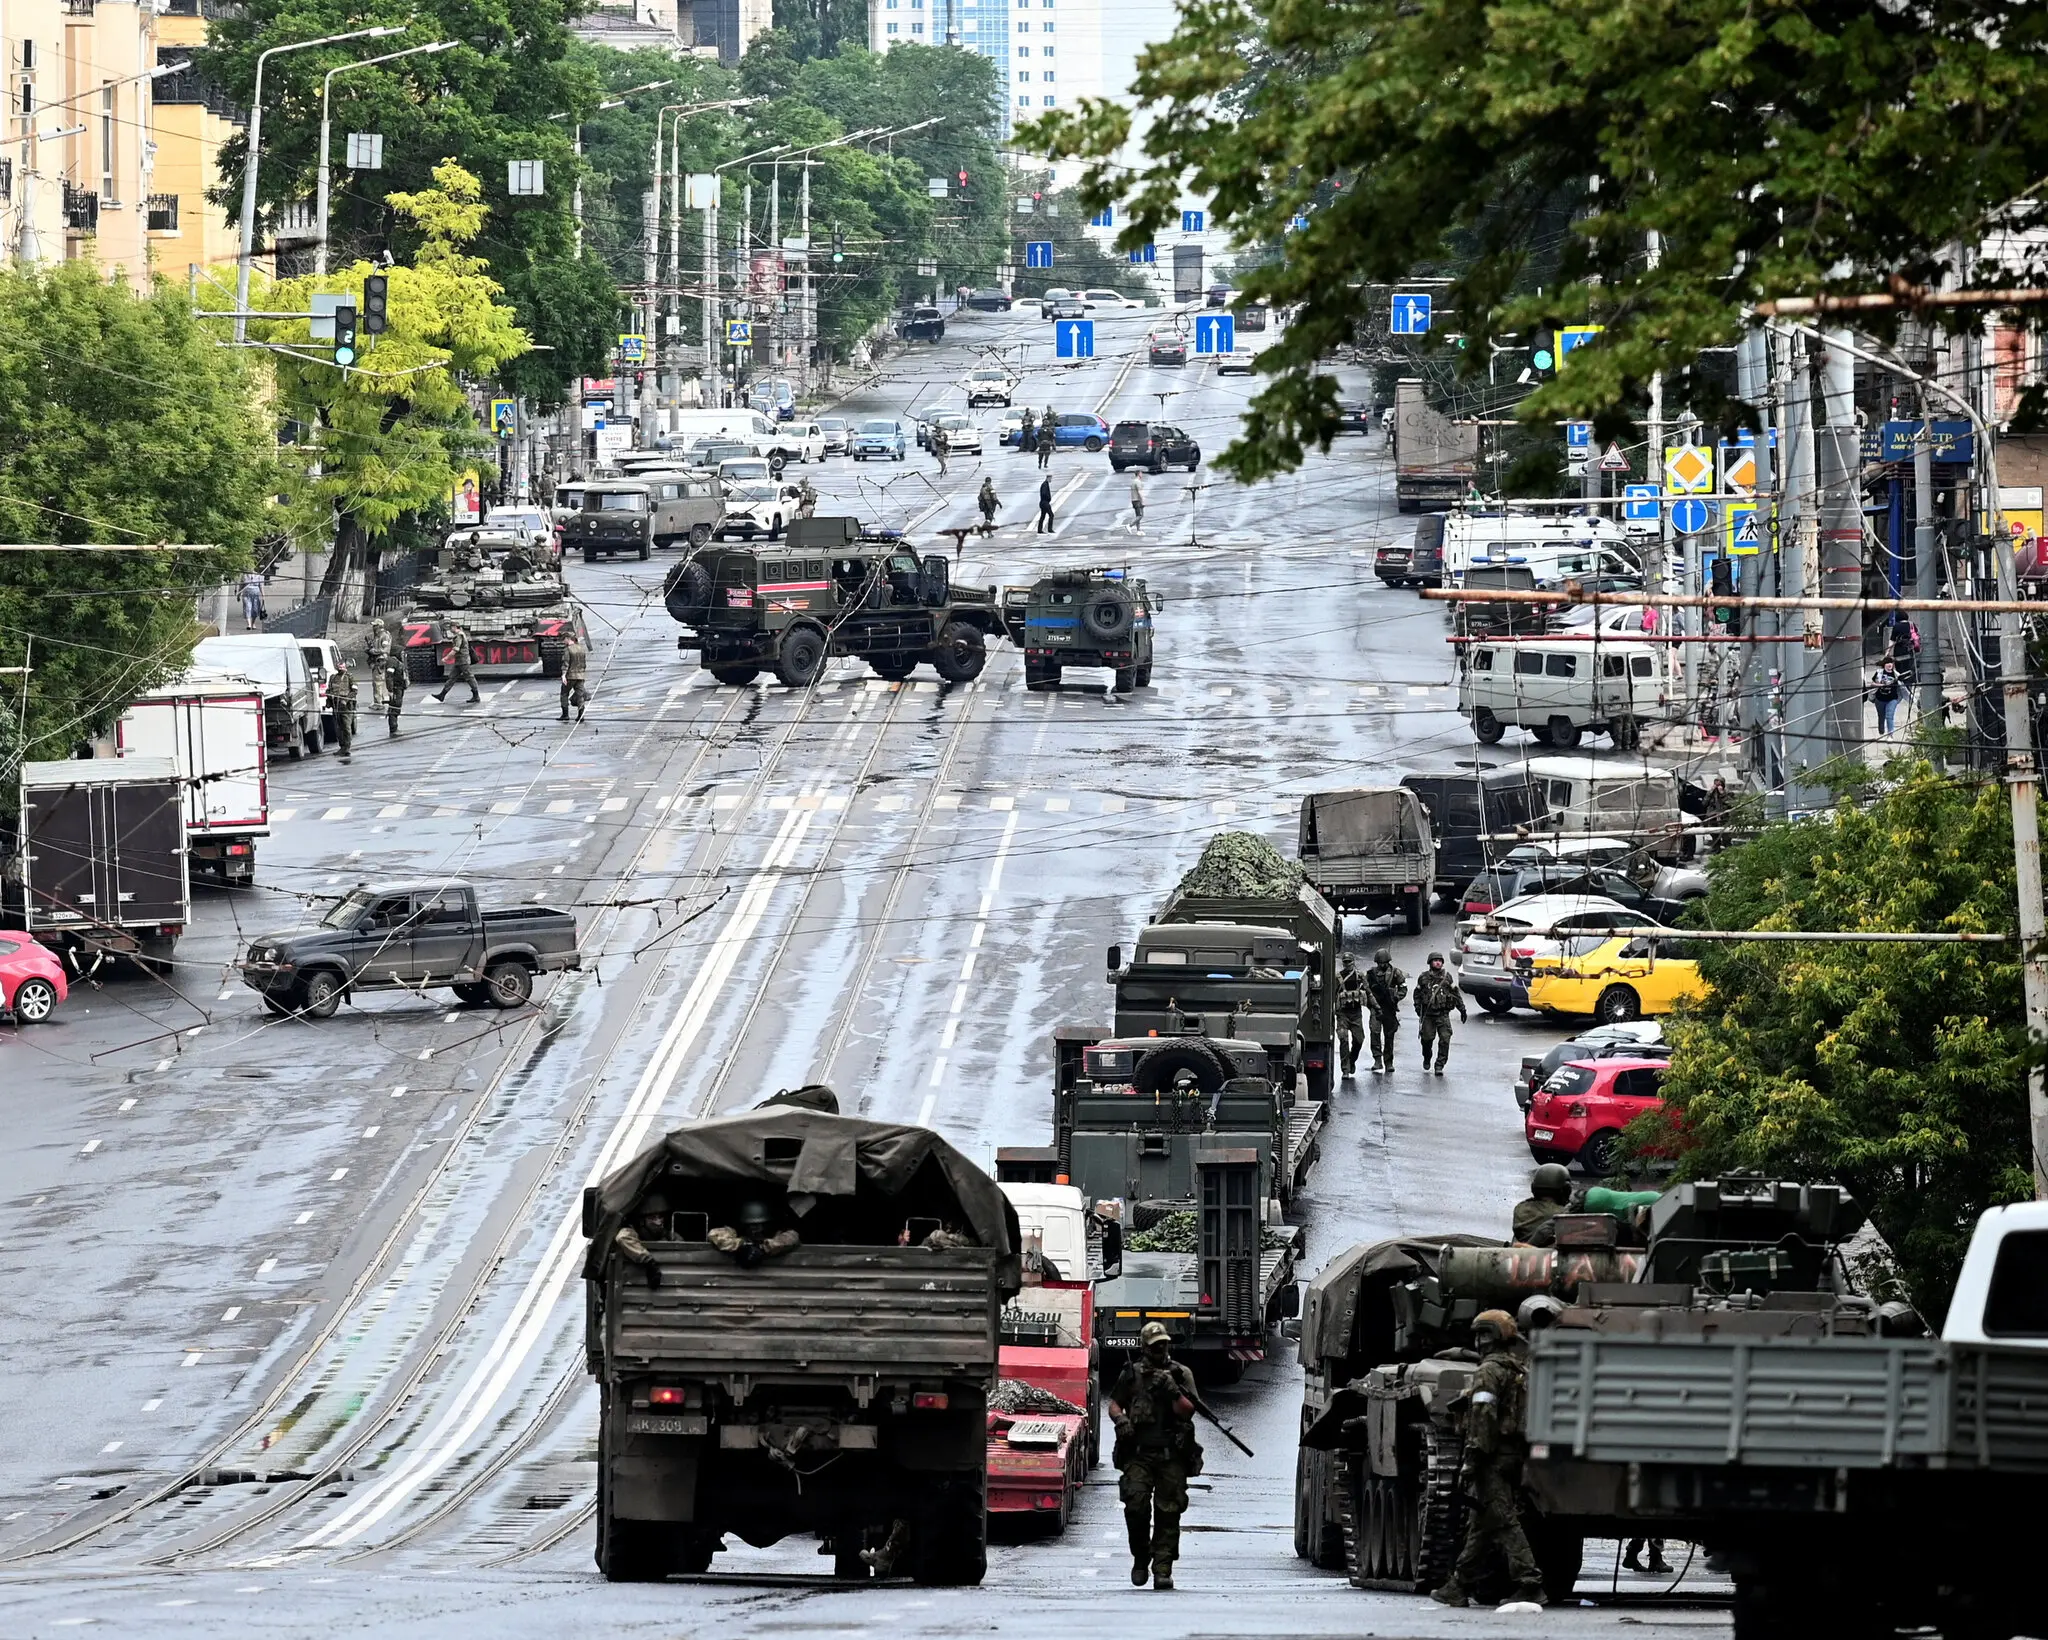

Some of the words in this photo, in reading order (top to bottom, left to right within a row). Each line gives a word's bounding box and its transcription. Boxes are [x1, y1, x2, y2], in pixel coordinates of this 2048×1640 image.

[344, 330, 354, 344] 2
[1893, 433, 1953, 443] МАСТР
[1633, 489, 1651, 515] P
[404, 624, 431, 647] Z
[442, 645, 535, 664] СБИРЬ
